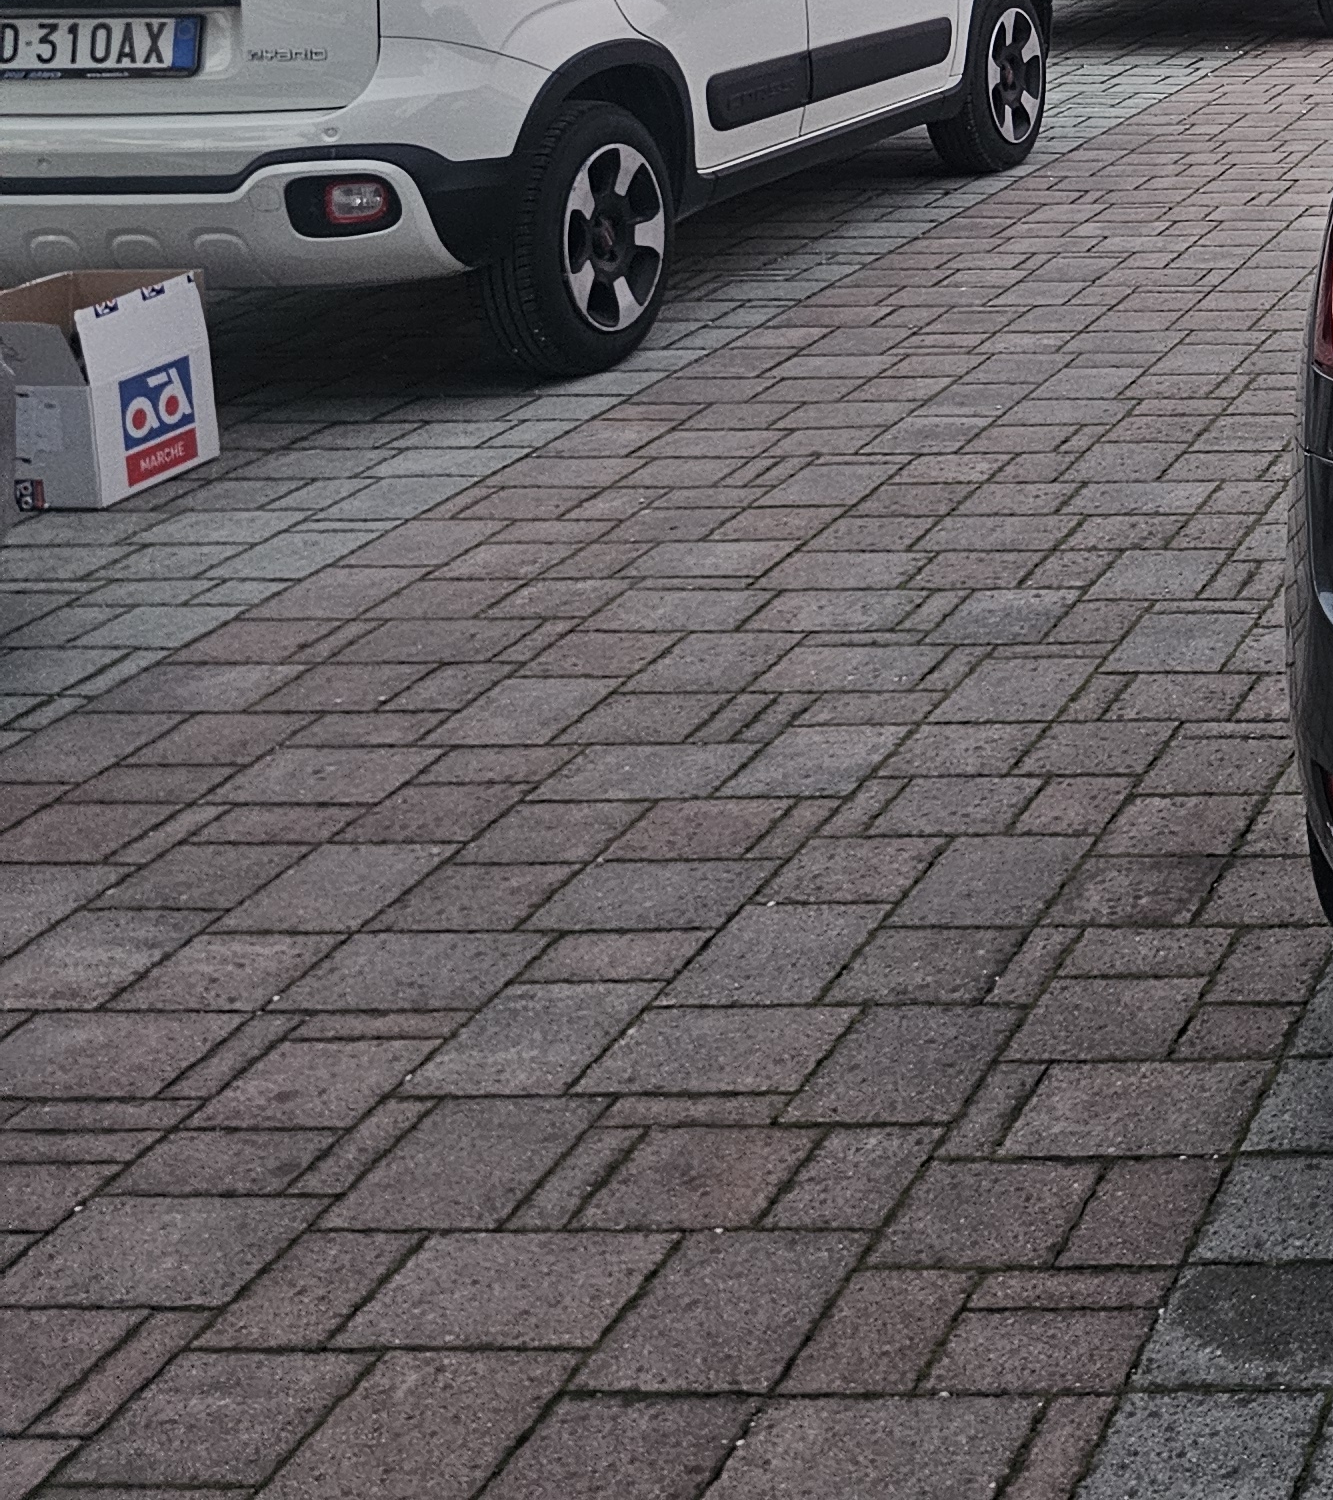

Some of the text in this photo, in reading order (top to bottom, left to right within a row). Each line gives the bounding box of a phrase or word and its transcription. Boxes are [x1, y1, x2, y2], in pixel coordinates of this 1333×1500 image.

[35, 21, 168, 65] 310AX
[125, 367, 193, 438] ad
[140, 441, 186, 472] MARCHE
